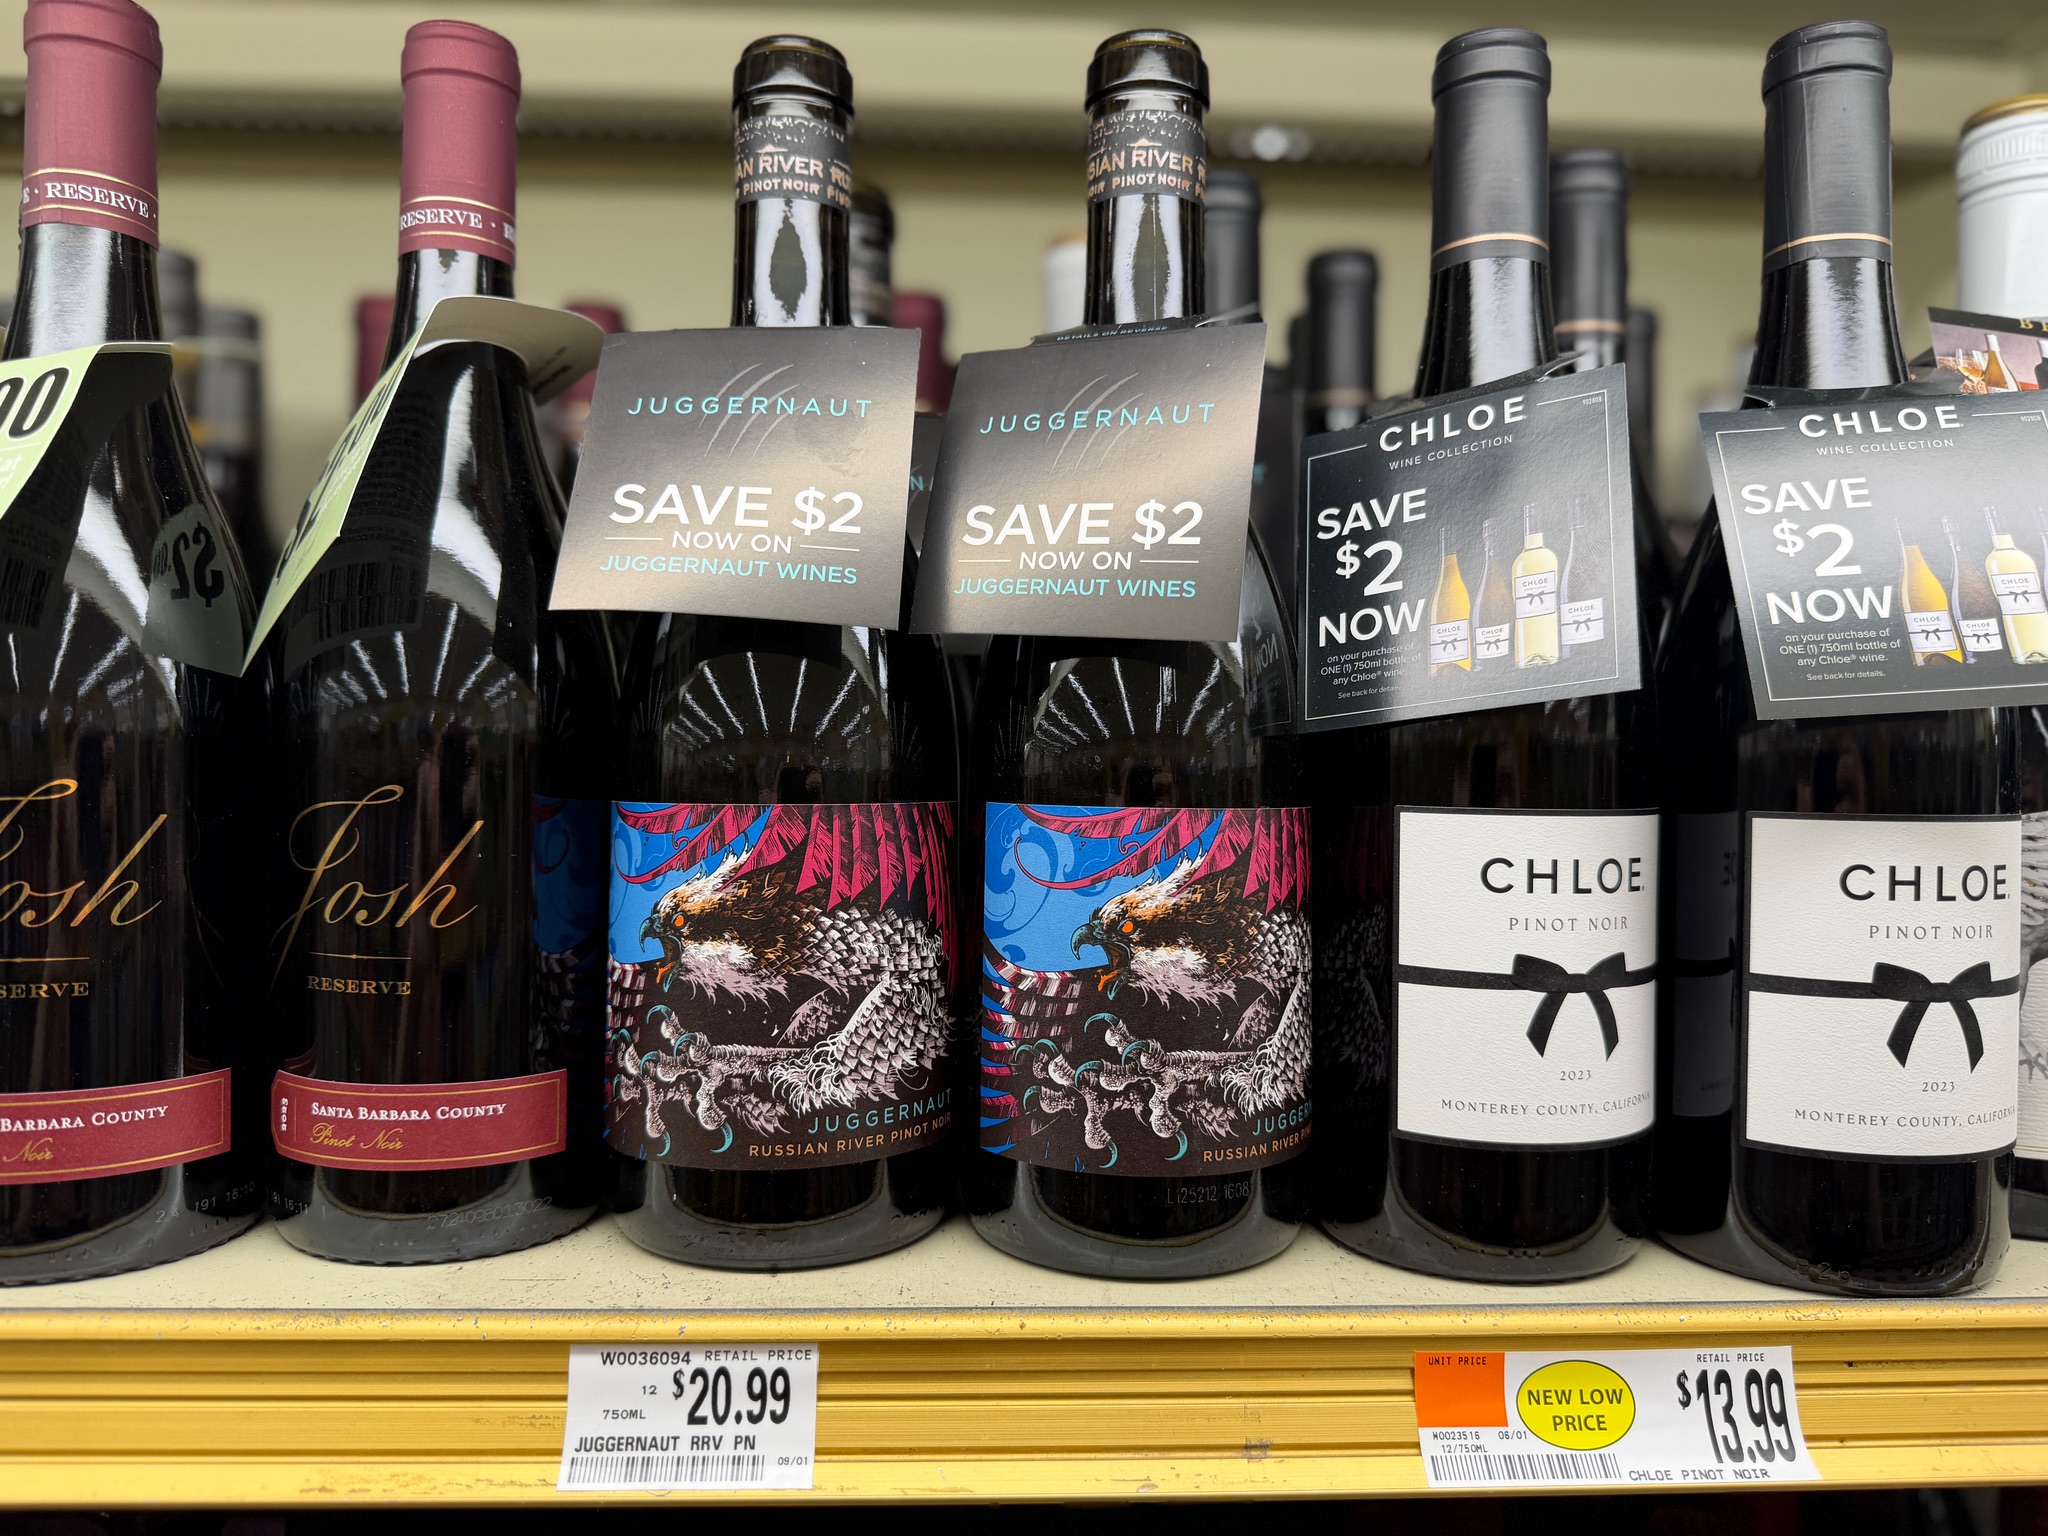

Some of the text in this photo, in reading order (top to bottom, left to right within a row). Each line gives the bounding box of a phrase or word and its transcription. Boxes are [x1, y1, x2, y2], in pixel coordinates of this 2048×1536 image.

[758, 155, 824, 178] RIVER
[1131, 150, 1193, 175] RIVER
[743, 179, 781, 196] PINOT
[782, 179, 820, 195] NOIR
[1112, 173, 1155, 190] PINOT
[1157, 174, 1190, 192] NOIR
[45, 182, 149, 218] RESERVE
[400, 208, 483, 231] RESERVE
[627, 396, 872, 418] JUGGERNAUT
[979, 403, 1215, 434] JUGGERNAUT
[1379, 395, 1526, 453] CHLOE
[1798, 404, 1963, 438] CHLOE
[1389, 434, 1514, 470] WINE COLLECTION
[1816, 438, 1955, 456] WINE COLLECTION
[1740, 476, 1873, 515] SAVE
[608, 483, 863, 536] SAVE $2
[1316, 487, 1428, 540] SAVE
[961, 499, 1204, 550] SAVE $2
[672, 531, 793, 554] NOW ON
[1772, 518, 1862, 577] $2
[600, 555, 858, 584] JUGGERNAUT WINES
[1018, 551, 1133, 570] NOW ON
[1334, 540, 1404, 597] $2
[953, 578, 1197, 598] JUGGERNAUT WINES
[1522, 577, 1549, 588] CHLOE
[2001, 577, 2030, 585] CHLOE
[1567, 604, 1595, 614] CHLOE
[1765, 585, 1894, 625] NOW
[1317, 598, 1427, 648] NOW
[1437, 625, 1461, 635] CHLOE
[1481, 627, 1503, 636] CHLOE
[1785, 628, 1890, 643] on your purchase of
[1327, 642, 1415, 664] on your purchase of
[1779, 639, 1902, 655] ONE (1) 750ml bottle of
[1320, 653, 1421, 676] ONE (1) 750ml bottle of
[1797, 657, 1816, 668] any
[1858, 653, 1889, 663] wine.
[1332, 676, 1349, 686] any
[1806, 673, 1822, 681] See
[1824, 671, 1843, 680] back
[1844, 671, 1855, 679] for
[1352, 689, 1368, 697] back
[1369, 687, 1378, 695] for
[1479, 856, 1645, 896] CHLOE
[1838, 863, 2011, 902] CHLOE
[270, 784, 485, 993] Josh
[1508, 915, 1630, 933] PINOT NOIR
[1868, 923, 1995, 940] PINOT NOIR
[307, 976, 412, 995] RESERVE
[1560, 1069, 1592, 1081] 2023
[1921, 1081, 1956, 1093] 2023
[92, 1105, 169, 1126] COUNTY
[310, 1101, 507, 1121] SANTA BARBARA COUNTY
[807, 1087, 952, 1135] JUGGERNAUT
[1441, 1098, 1529, 1116] MONTEREY
[1536, 1103, 1598, 1116] COUNTY,
[1794, 1108, 1889, 1127] MONTEREY
[1896, 1115, 1962, 1128] COUNTY,
[310, 1122, 404, 1150] Pinot Noir
[749, 1111, 951, 1157] RUSSIAN RIVER PINOT NOIR
[2, 1137, 54, 1162] Noir
[1203, 1143, 1267, 1162] RUSSIAN
[1272, 1132, 1300, 1152] RIVER
[194, 1196, 217, 1213] 191
[600, 1351, 692, 1366] W0036094
[704, 1349, 812, 1361] RETAIL PRICE
[1428, 1356, 1487, 1366] UNIT PRICE
[1696, 1353, 1766, 1363] RETAIL PRICE
[641, 1384, 657, 1395] 12
[672, 1365, 791, 1426] $20.99
[1527, 1388, 1624, 1406] NEW LOW
[602, 1408, 647, 1420] 750ML
[1551, 1414, 1608, 1432] PRICE
[1676, 1368, 1797, 1464] $13.99
[574, 1434, 757, 1453] JUGGERNAUT RRV PN
[1432, 1430, 1528, 1441] W0023516 06/01
[1441, 1443, 1489, 1454] 12/750ML
[777, 1456, 809, 1466] 09/01
[1628, 1468, 1771, 1482] CHLOE PINOT NOIR
